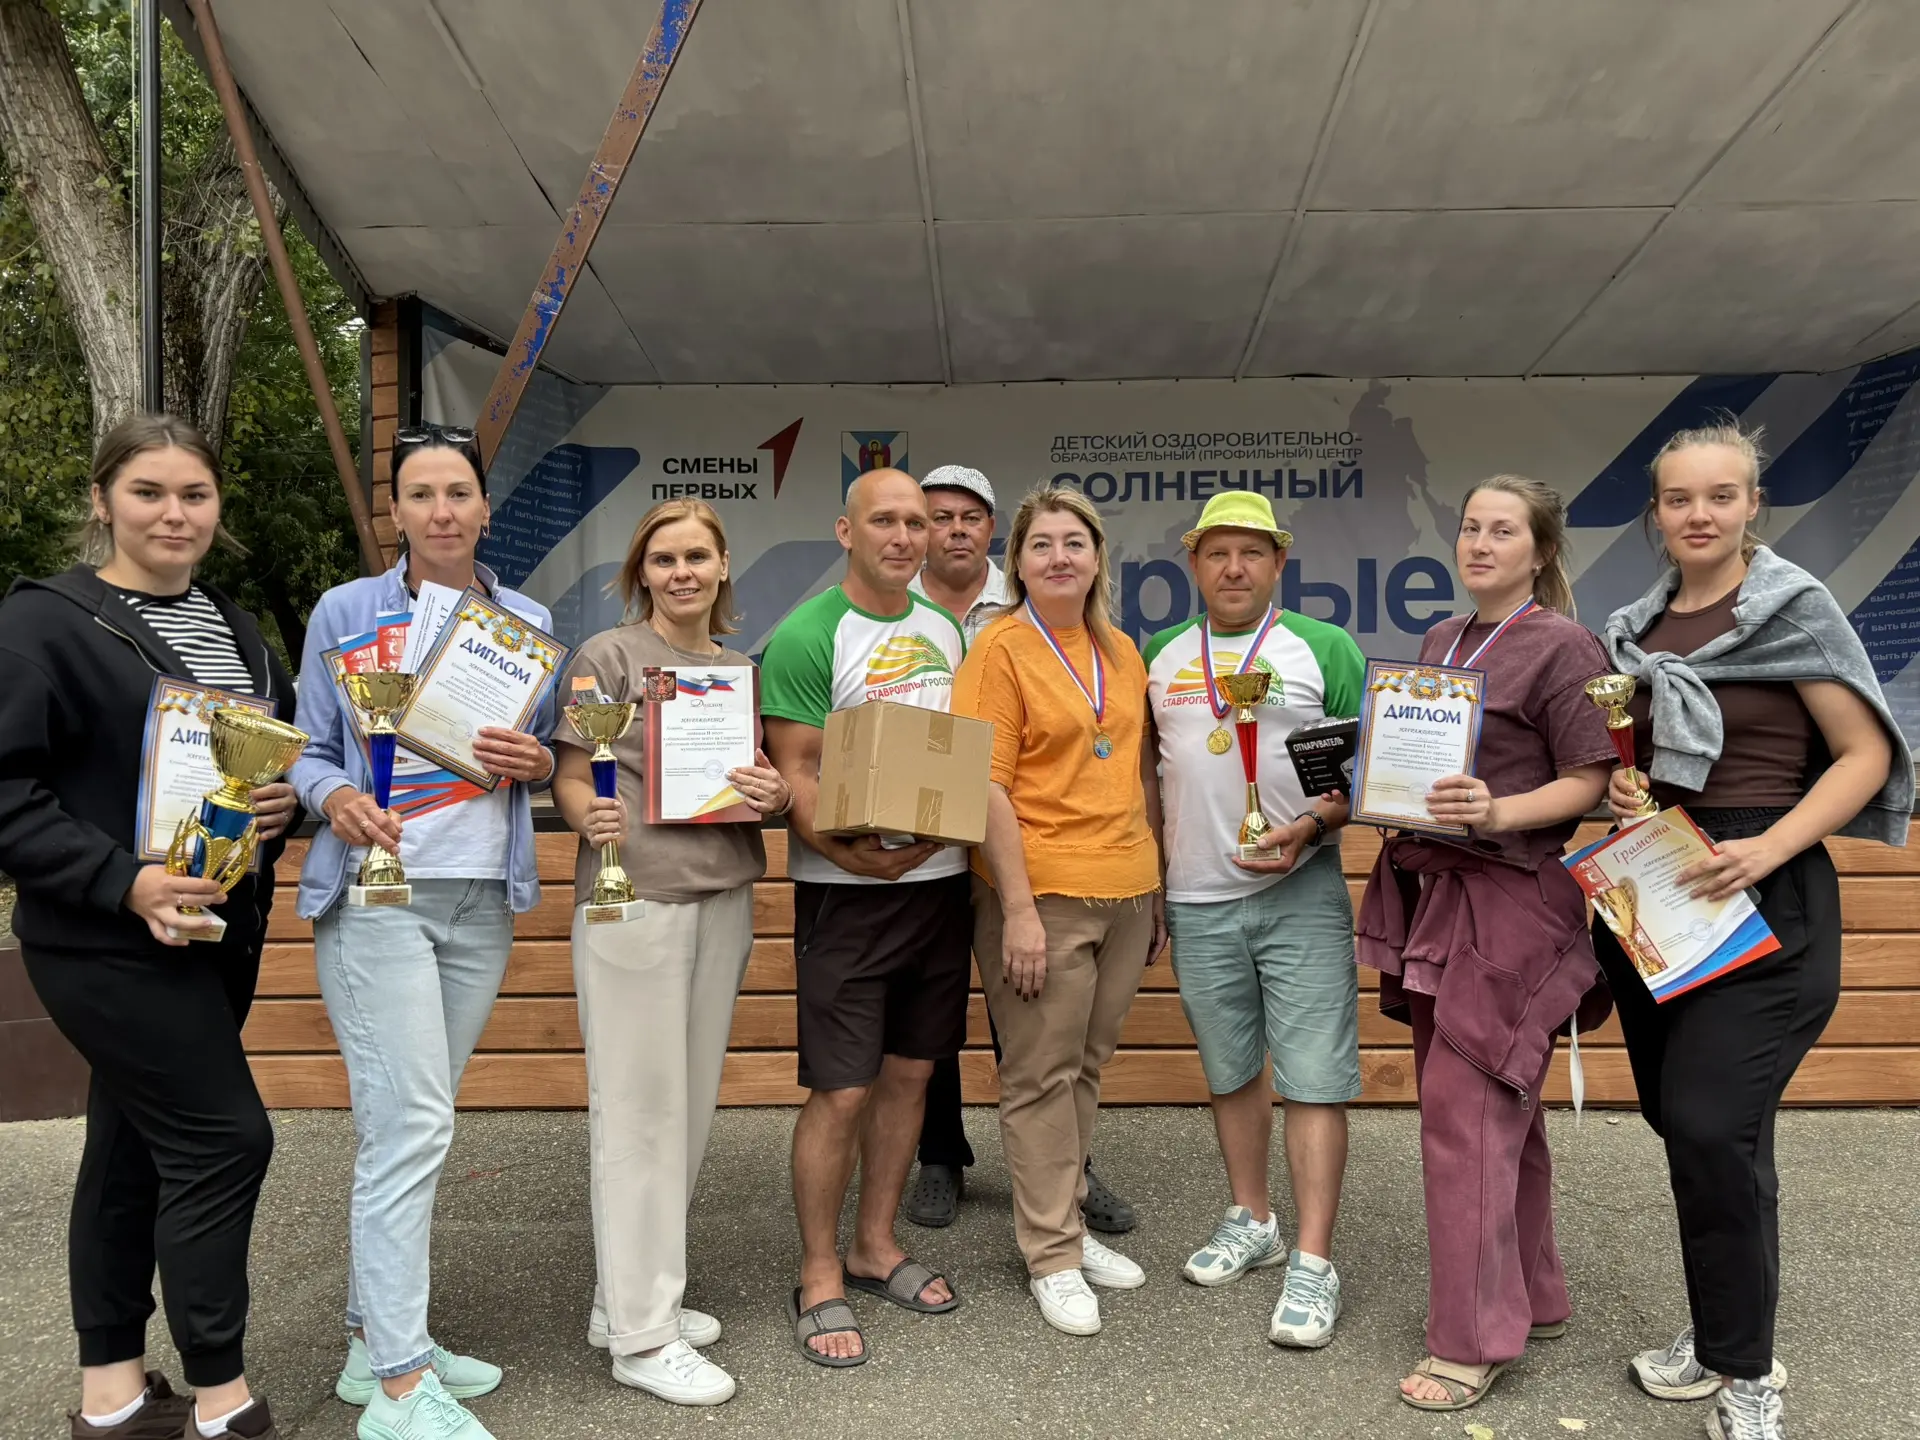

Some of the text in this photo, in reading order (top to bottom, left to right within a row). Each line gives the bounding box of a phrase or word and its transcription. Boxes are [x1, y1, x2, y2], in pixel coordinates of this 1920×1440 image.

[1051, 430, 1364, 453] ДЕТСКИЙ ОЗДОРОВИТЕЛЬНО-
[1050, 447, 1363, 464] ОБРАЗОВАТЕЛЬНЫЙ (ПРОФИЛЬНЫЙ) ЦЕНТР
[662, 457, 758, 475] СМЕНЫ
[1050, 460, 1363, 504] СОЛНЕЧНЫЙ
[652, 483, 758, 500] ПЕРВЫХ
[1870, 593, 1898, 603] БЫТЬ
[1871, 623, 1899, 632] БЫТЬ
[459, 637, 533, 685] ДИПЛОМ
[1872, 653, 1900, 661] БЫТЬ
[1383, 703, 1462, 725] ДИПЛОМ
[170, 728, 209, 747] ДИП
[1612, 822, 1671, 866] Грамота
